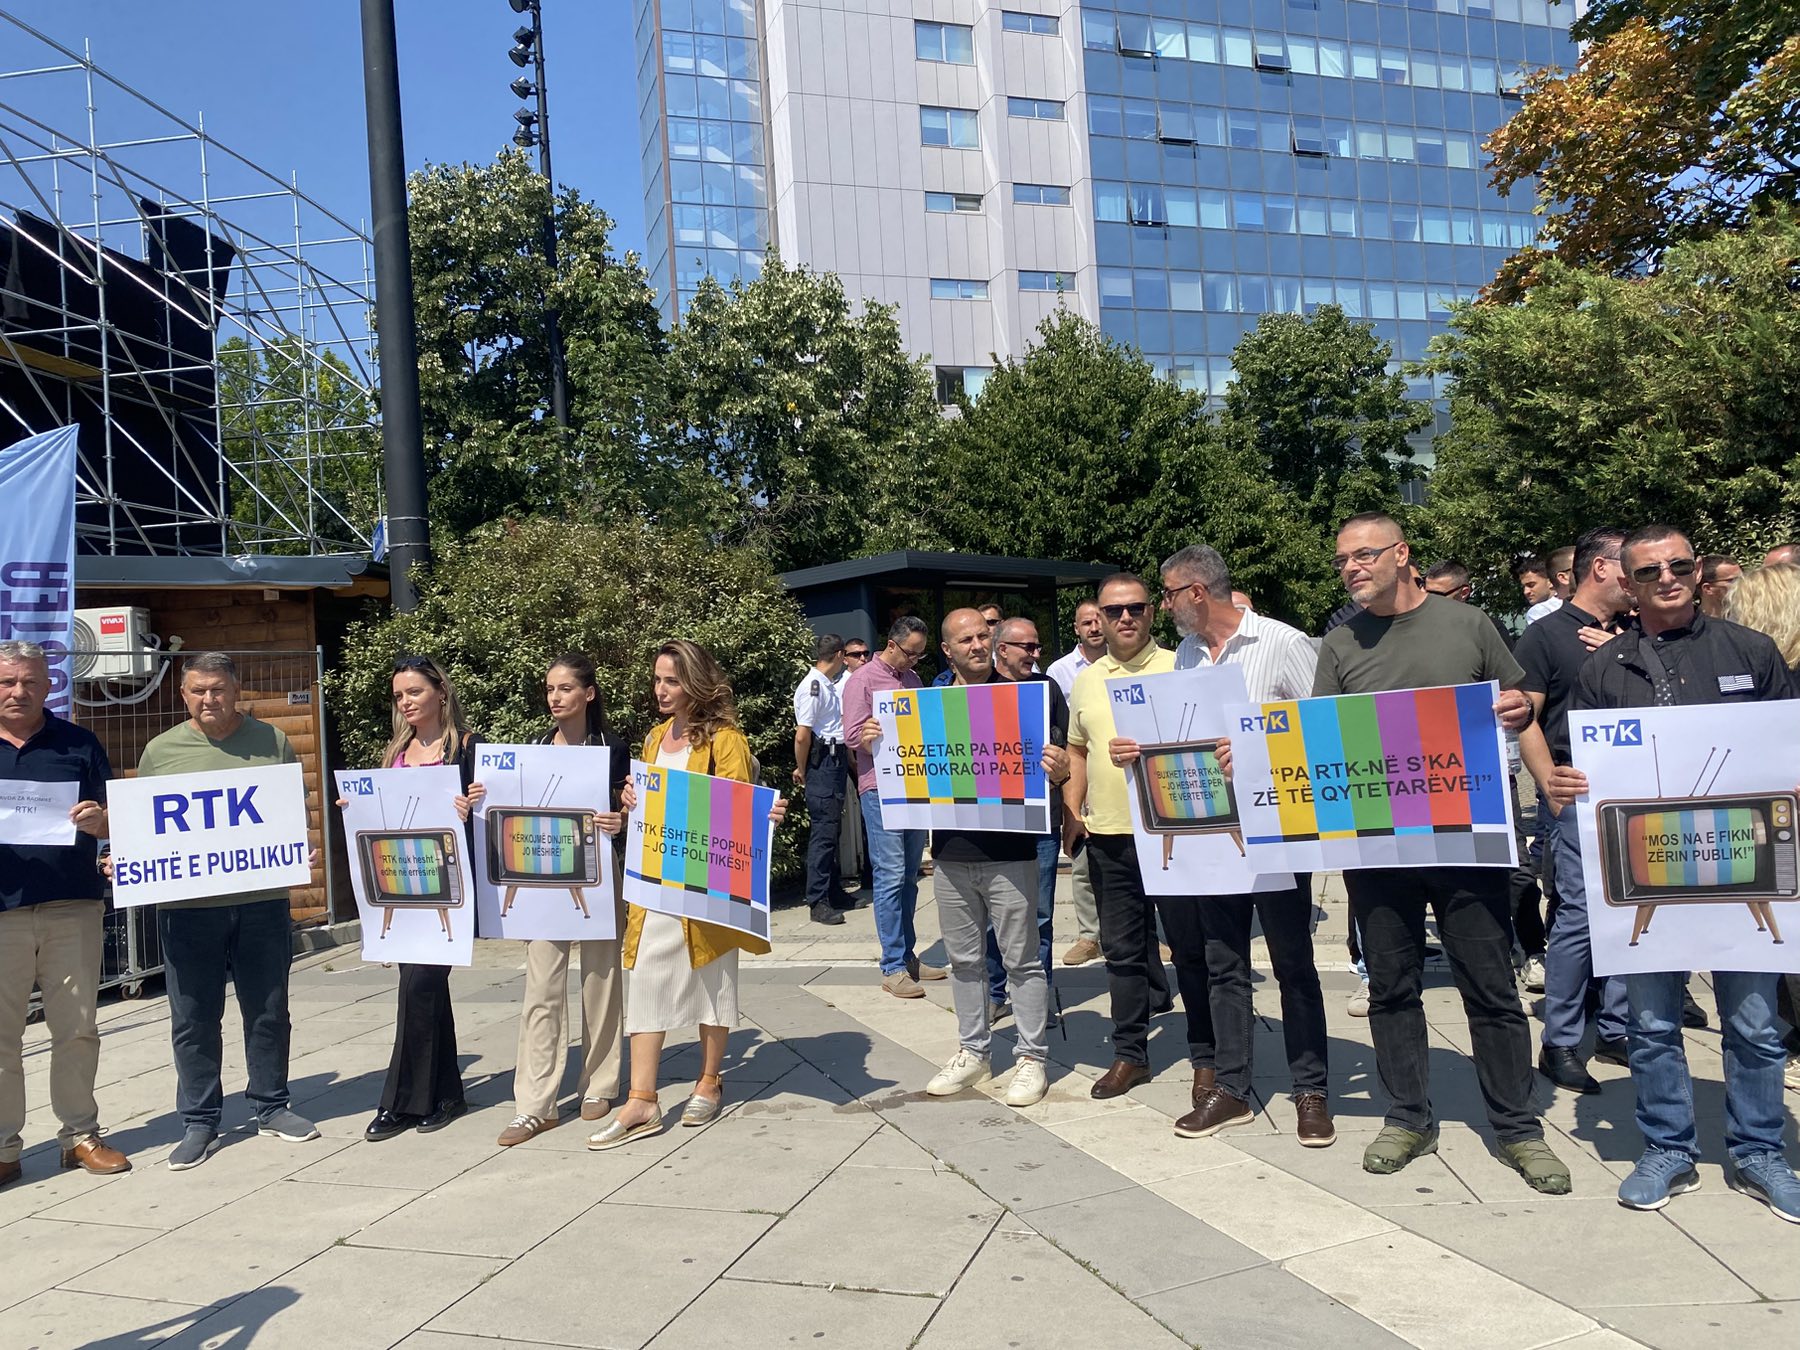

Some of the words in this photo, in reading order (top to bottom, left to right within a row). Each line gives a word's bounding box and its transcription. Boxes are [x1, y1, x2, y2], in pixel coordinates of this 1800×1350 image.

[101, 617, 124, 625] VIVAX
[1113, 683, 1146, 705] RTK
[879, 697, 912, 716] RTK
[1240, 710, 1290, 734] RTK
[1581, 719, 1643, 746] RTK
[889, 743, 966, 758] “GAZETAR
[969, 742, 990, 756] PA
[993, 738, 1034, 756] PAGË
[481, 752, 516, 770] RTK
[896, 761, 986, 777] DEMOKRACI
[989, 762, 1009, 776] PA
[1270, 764, 1311, 783] “PA
[1315, 755, 1400, 780] RTK-NË
[342, 777, 374, 795] RTK
[635, 772, 661, 792] RTK
[1253, 786, 1281, 807] ZË
[1289, 784, 1315, 804] TË
[1321, 773, 1492, 803] QYTETARËVE!”
[16, 805, 37, 814] RTK!
[152, 785, 264, 835] RTK
[660, 824, 698, 844] ËSHTË
[701, 834, 709, 846] E
[712, 836, 763, 860] POPULLIT
[1683, 832, 1703, 845] NA
[1706, 831, 1715, 844] E
[1719, 828, 1754, 843] FIKNI
[116, 851, 182, 887] ËSHTË
[188, 854, 201, 878] E
[207, 842, 305, 876] PUBLIKUT
[398, 855, 411, 864] nuk
[412, 854, 434, 864] hesht
[652, 841, 667, 854] JO
[670, 845, 678, 857] E
[681, 847, 750, 871] POLITIKËS!”
[1647, 848, 1688, 863] ZËRIN
[1693, 846, 1754, 862] PUBLIK!”
